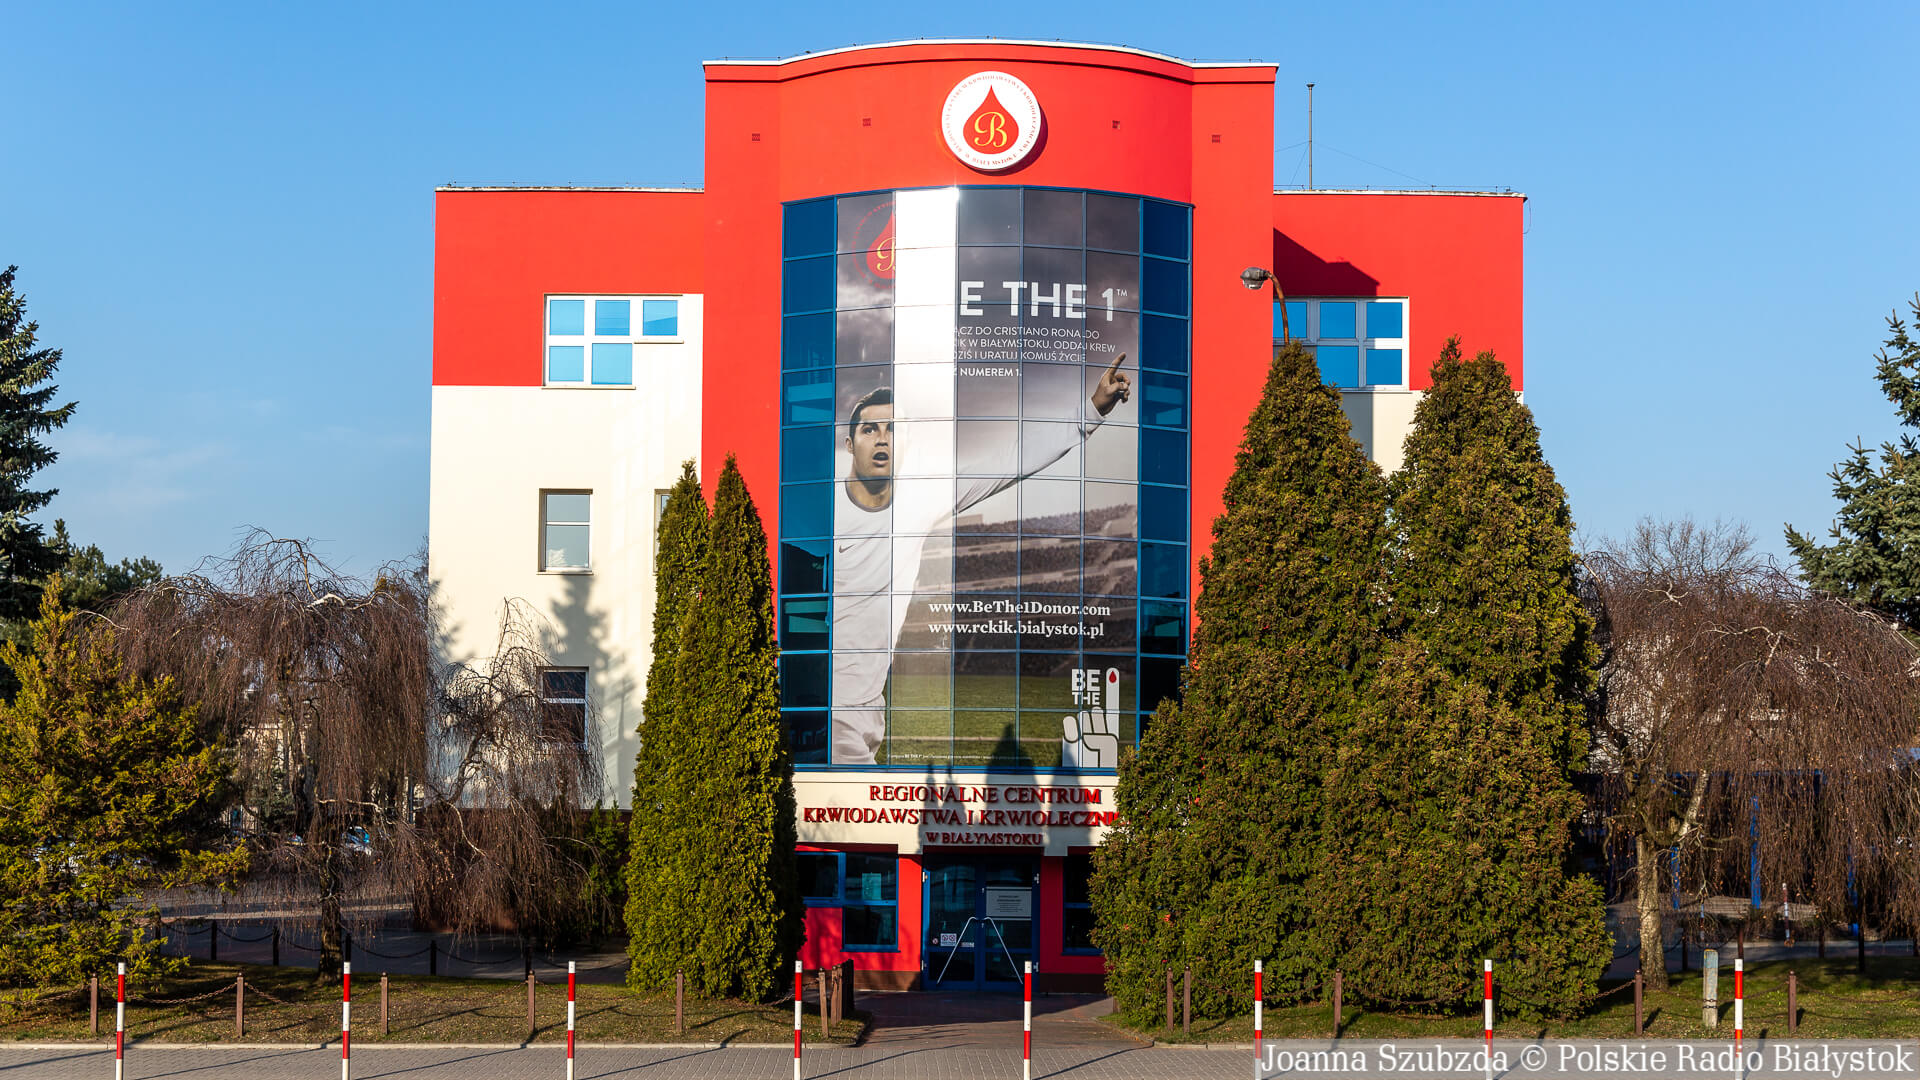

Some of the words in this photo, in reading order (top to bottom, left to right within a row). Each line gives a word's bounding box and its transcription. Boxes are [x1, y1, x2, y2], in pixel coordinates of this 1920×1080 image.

[974, 111, 1008, 148] B
[959, 281, 984, 316] E
[1002, 281, 1087, 319] THE
[975, 326, 992, 336] DO
[993, 326, 1049, 337] CRISTIANO
[968, 338, 978, 347] W
[980, 338, 1051, 349] BIAŁYMSTOKU.
[1053, 340, 1087, 350] ODDAJ
[1089, 342, 1116, 353] KREW
[980, 351, 1018, 360] URATUJ
[1020, 350, 1057, 361] KOMUŚ
[1058, 350, 1086, 362] ŻYCIE
[960, 367, 1014, 377] NUMEREM
[928, 600, 1111, 616] www.BeThe1Donor.com
[928, 620, 1105, 639] www.rckik.bialystok.pl
[1071, 669, 1101, 691] BE
[1071, 691, 1101, 706] THE
[869, 785, 999, 803] REGIONALNE
[1003, 786, 1102, 805] CENTRUM
[803, 807, 962, 826] KRWIODAWSTWA
[967, 809, 975, 826] I
[926, 831, 940, 843] W
[942, 832, 1043, 846] BIAŁYMSTOKU
